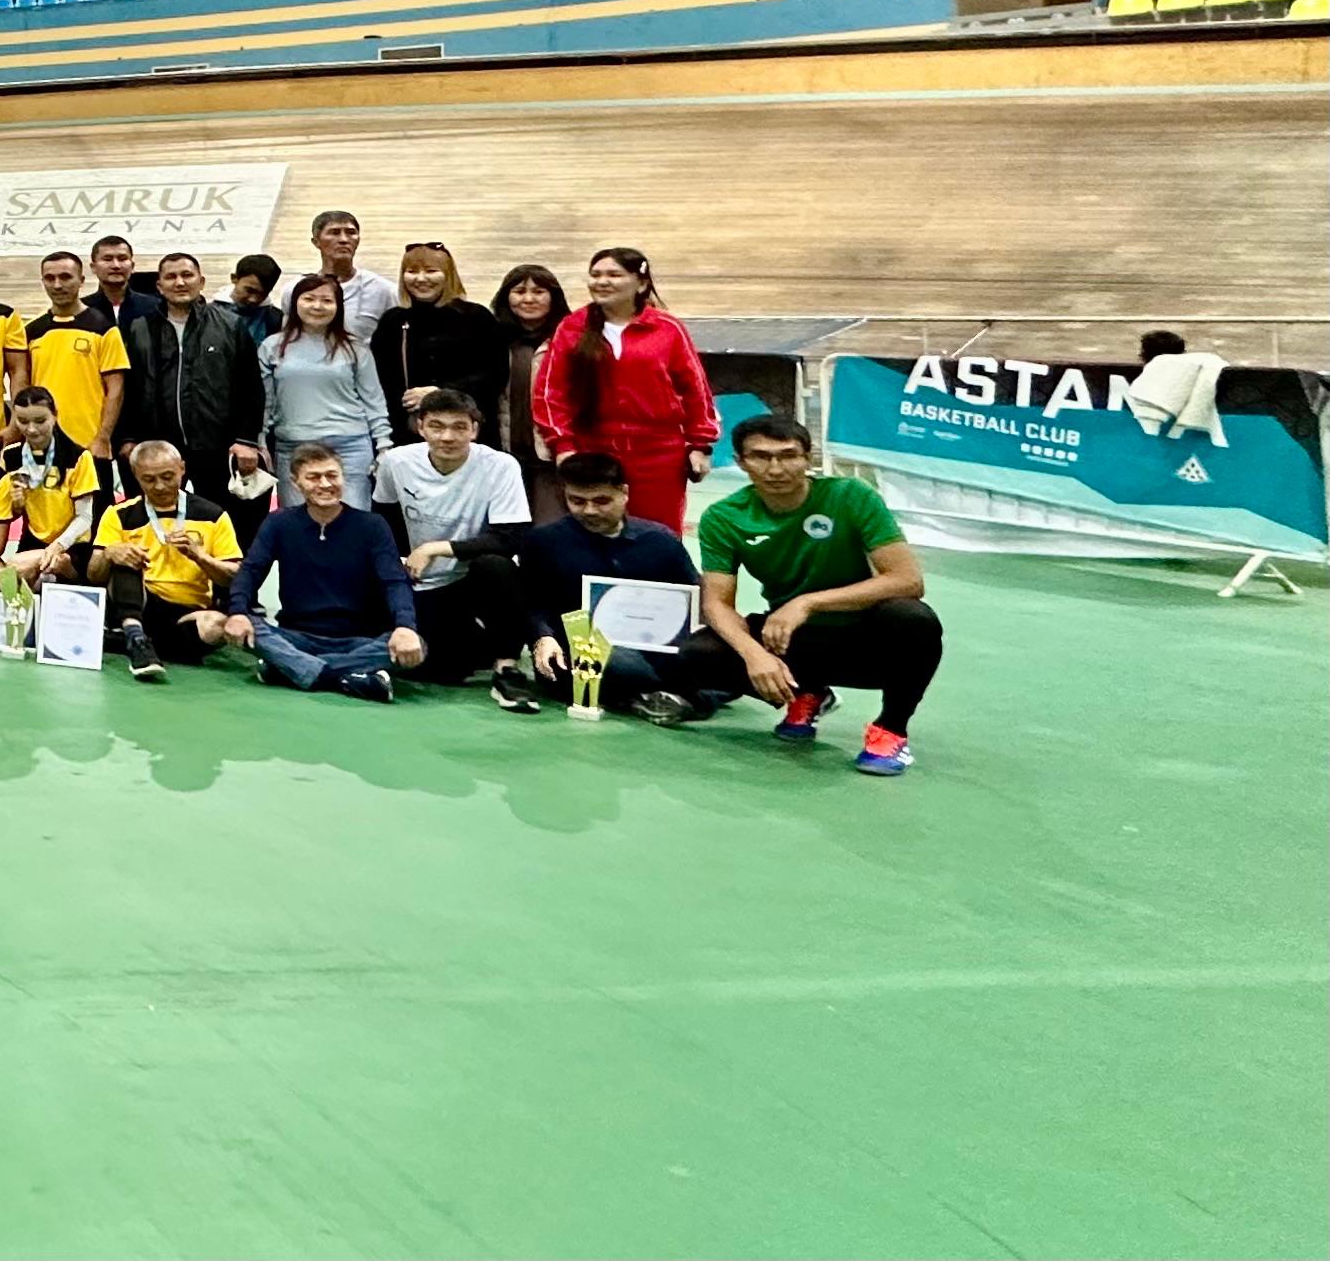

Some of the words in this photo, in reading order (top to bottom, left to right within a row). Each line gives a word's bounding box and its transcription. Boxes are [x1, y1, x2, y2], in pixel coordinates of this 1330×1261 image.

[6, 186, 239, 216] SAMRUK
[900, 401, 1020, 437] BASKETBALL
[1025, 422, 1081, 447] CLUB
